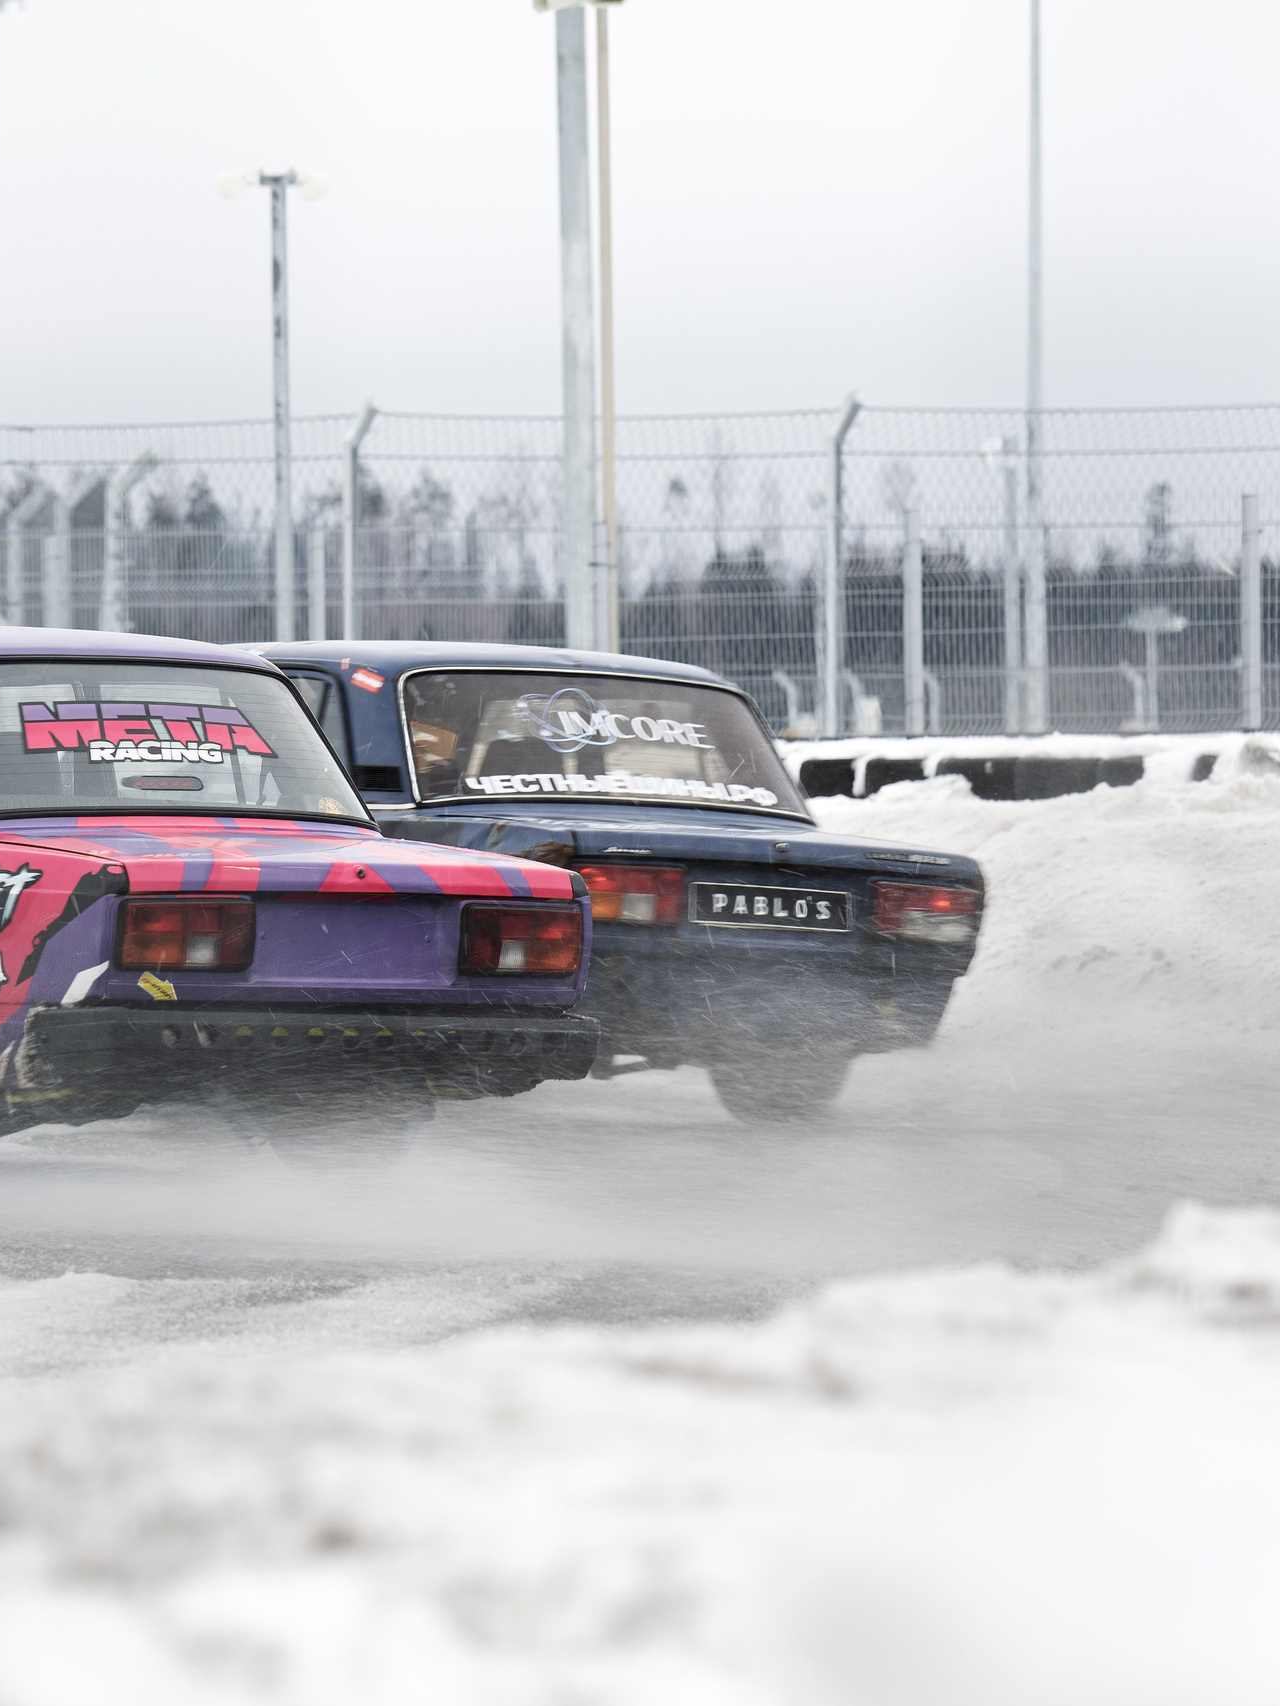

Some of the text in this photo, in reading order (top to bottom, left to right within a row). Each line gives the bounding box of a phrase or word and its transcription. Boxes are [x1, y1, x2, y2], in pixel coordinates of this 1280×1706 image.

[19, 701, 280, 758] META
[89, 740, 224, 763] RACING
[711, 894, 833, 920] PABLO'S
